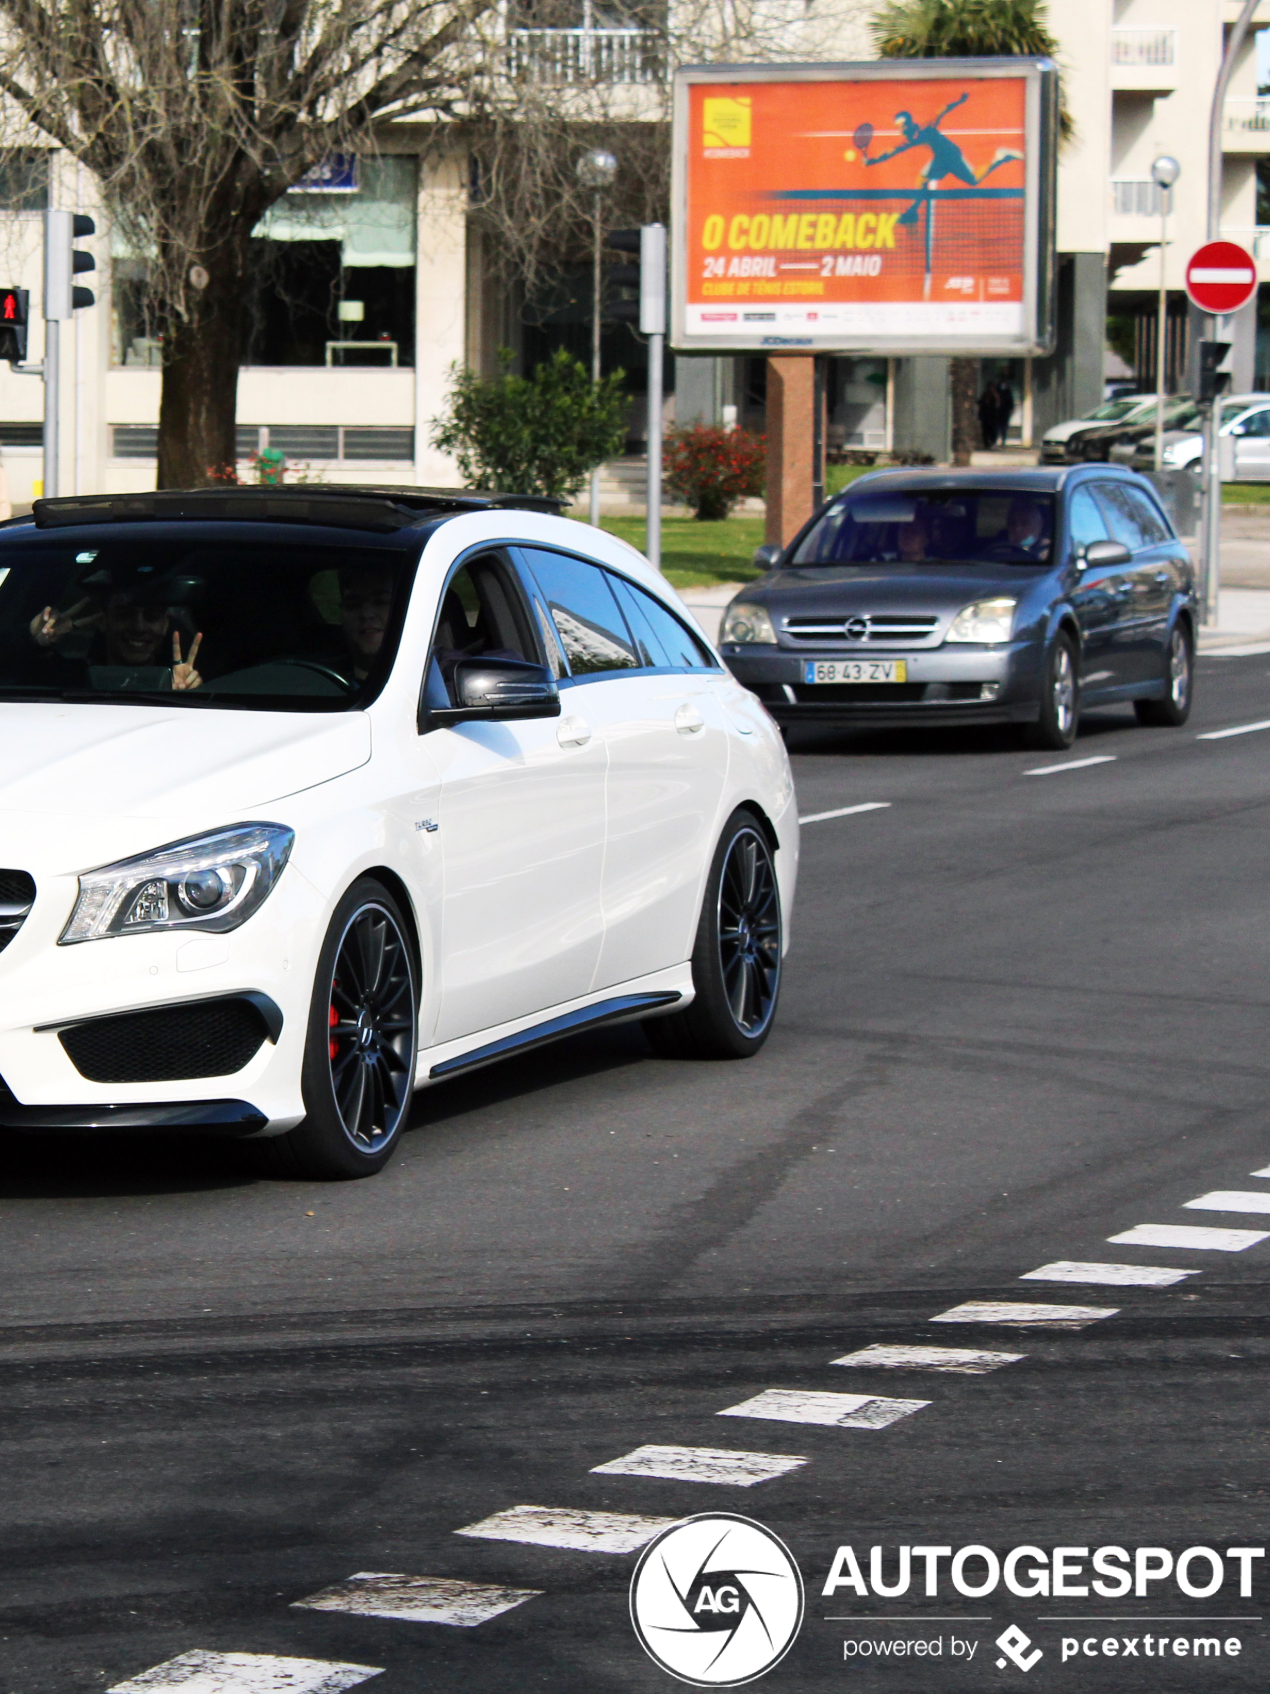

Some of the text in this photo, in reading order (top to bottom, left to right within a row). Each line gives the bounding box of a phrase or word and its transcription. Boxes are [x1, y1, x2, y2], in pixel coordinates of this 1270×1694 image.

[702, 213, 898, 251] O COMEBACK
[702, 256, 726, 278] 24
[727, 256, 777, 278] ABRIL
[820, 255, 834, 277] 2
[835, 254, 883, 277] MAIO
